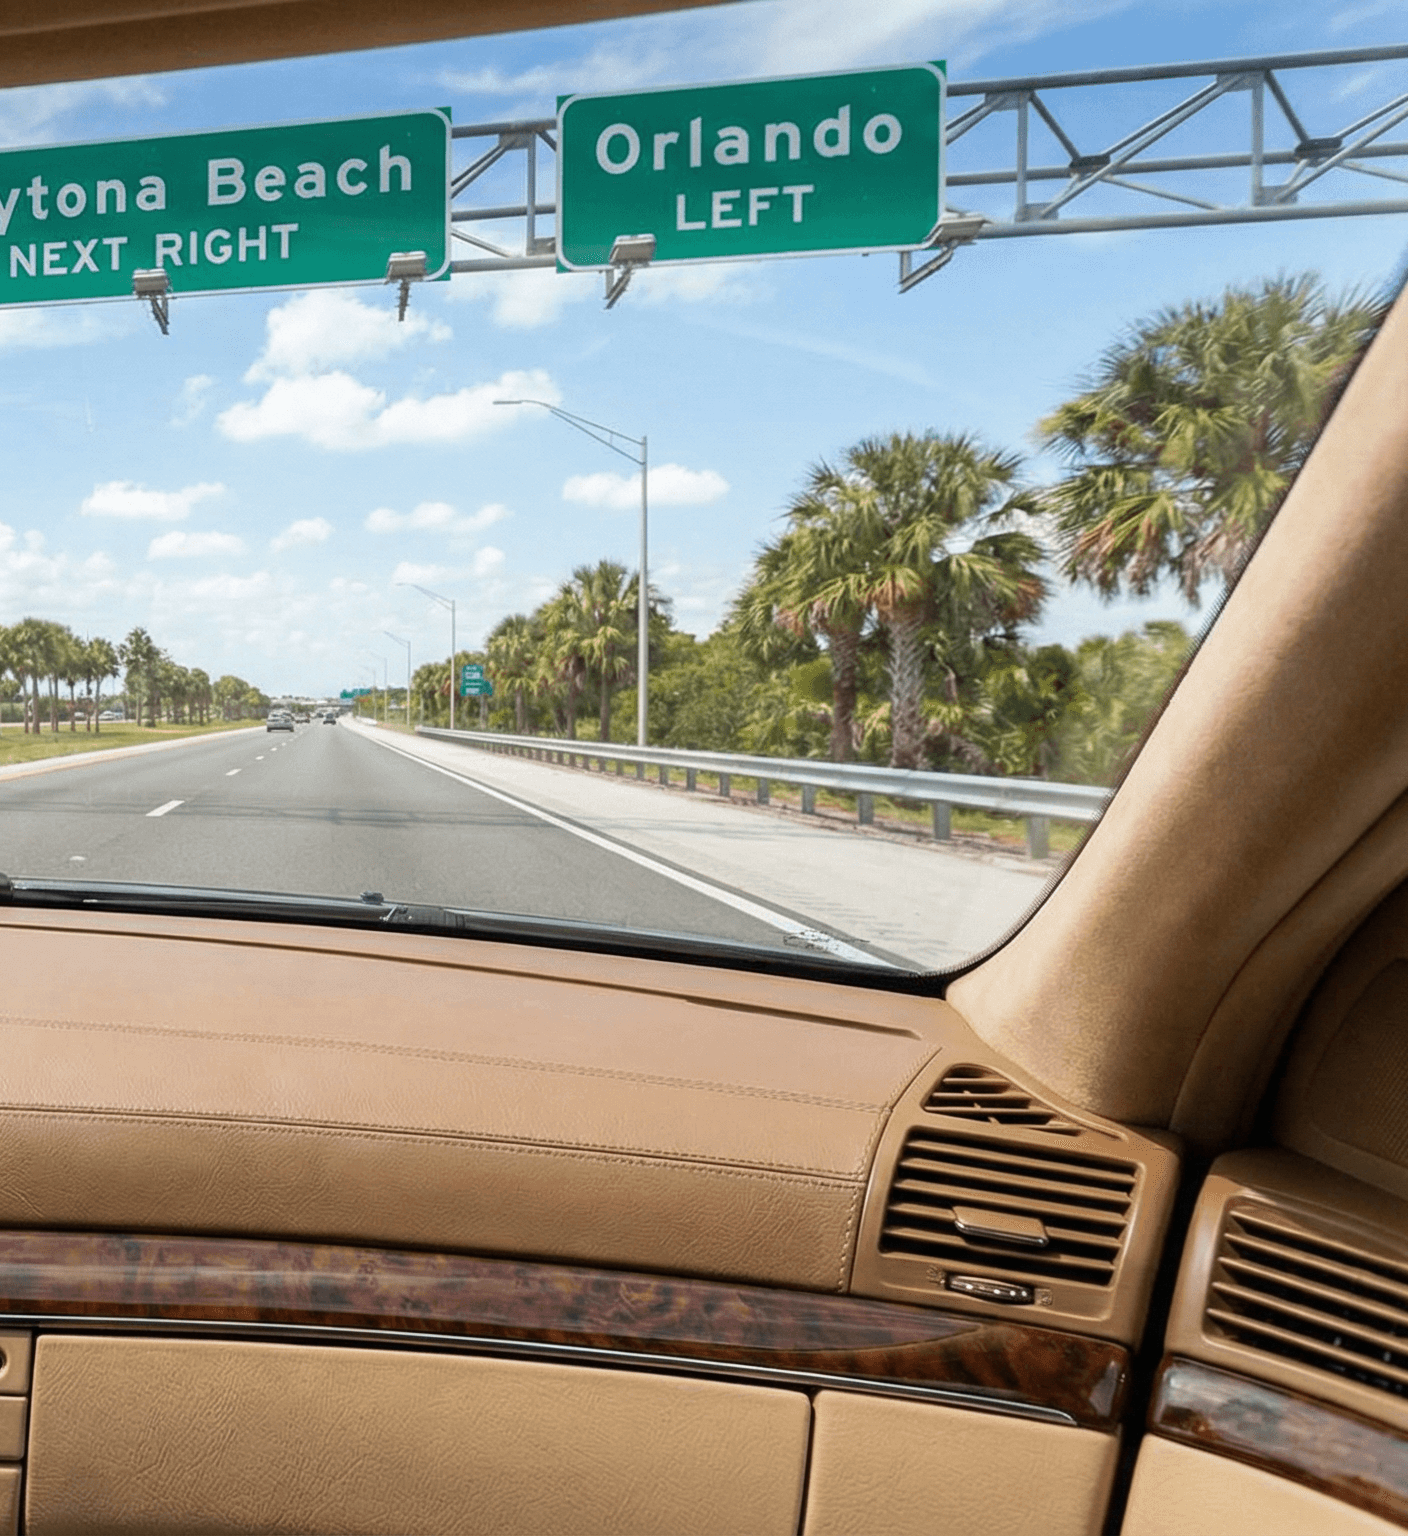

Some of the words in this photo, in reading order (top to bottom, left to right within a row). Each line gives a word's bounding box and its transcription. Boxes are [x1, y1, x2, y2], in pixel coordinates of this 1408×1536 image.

[595, 104, 902, 174] Orlando
[207, 144, 412, 206] Beach
[676, 184, 814, 231] LEFT
[9, 236, 128, 278] NEXT
[155, 222, 299, 268] RIGHT
